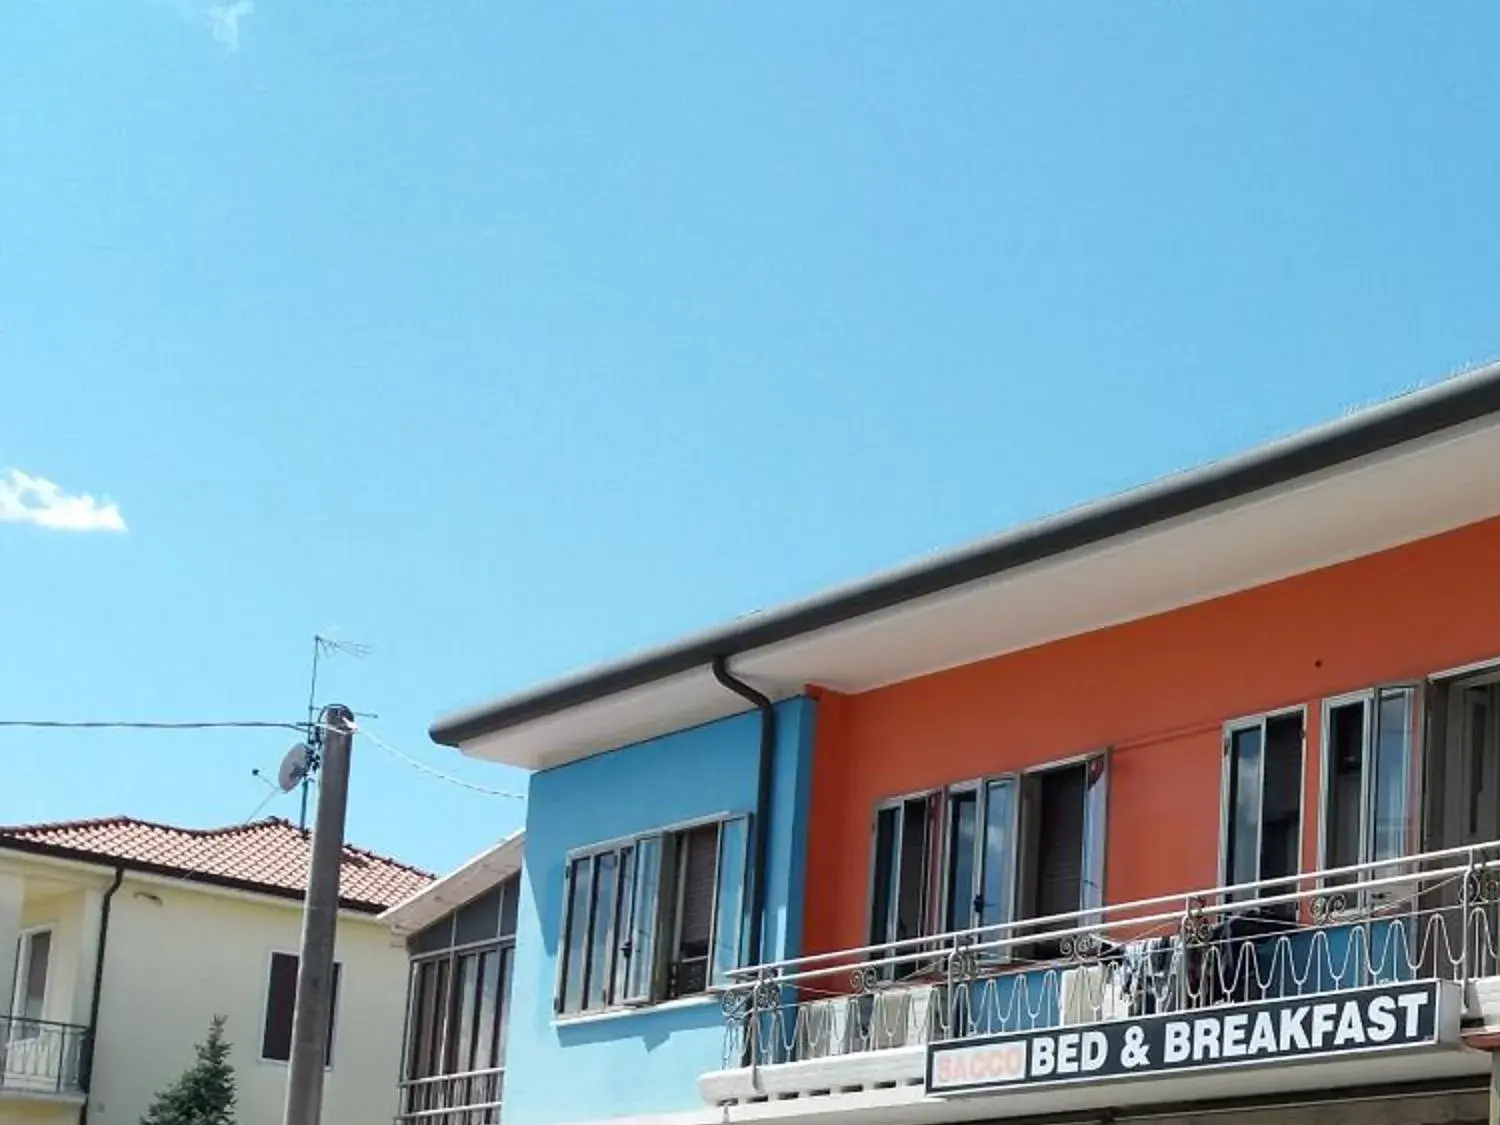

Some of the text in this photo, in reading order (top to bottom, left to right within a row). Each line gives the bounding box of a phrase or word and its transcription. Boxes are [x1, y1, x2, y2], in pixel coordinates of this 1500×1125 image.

[937, 991, 1430, 1083] SACCO BED & BREAKFAST
